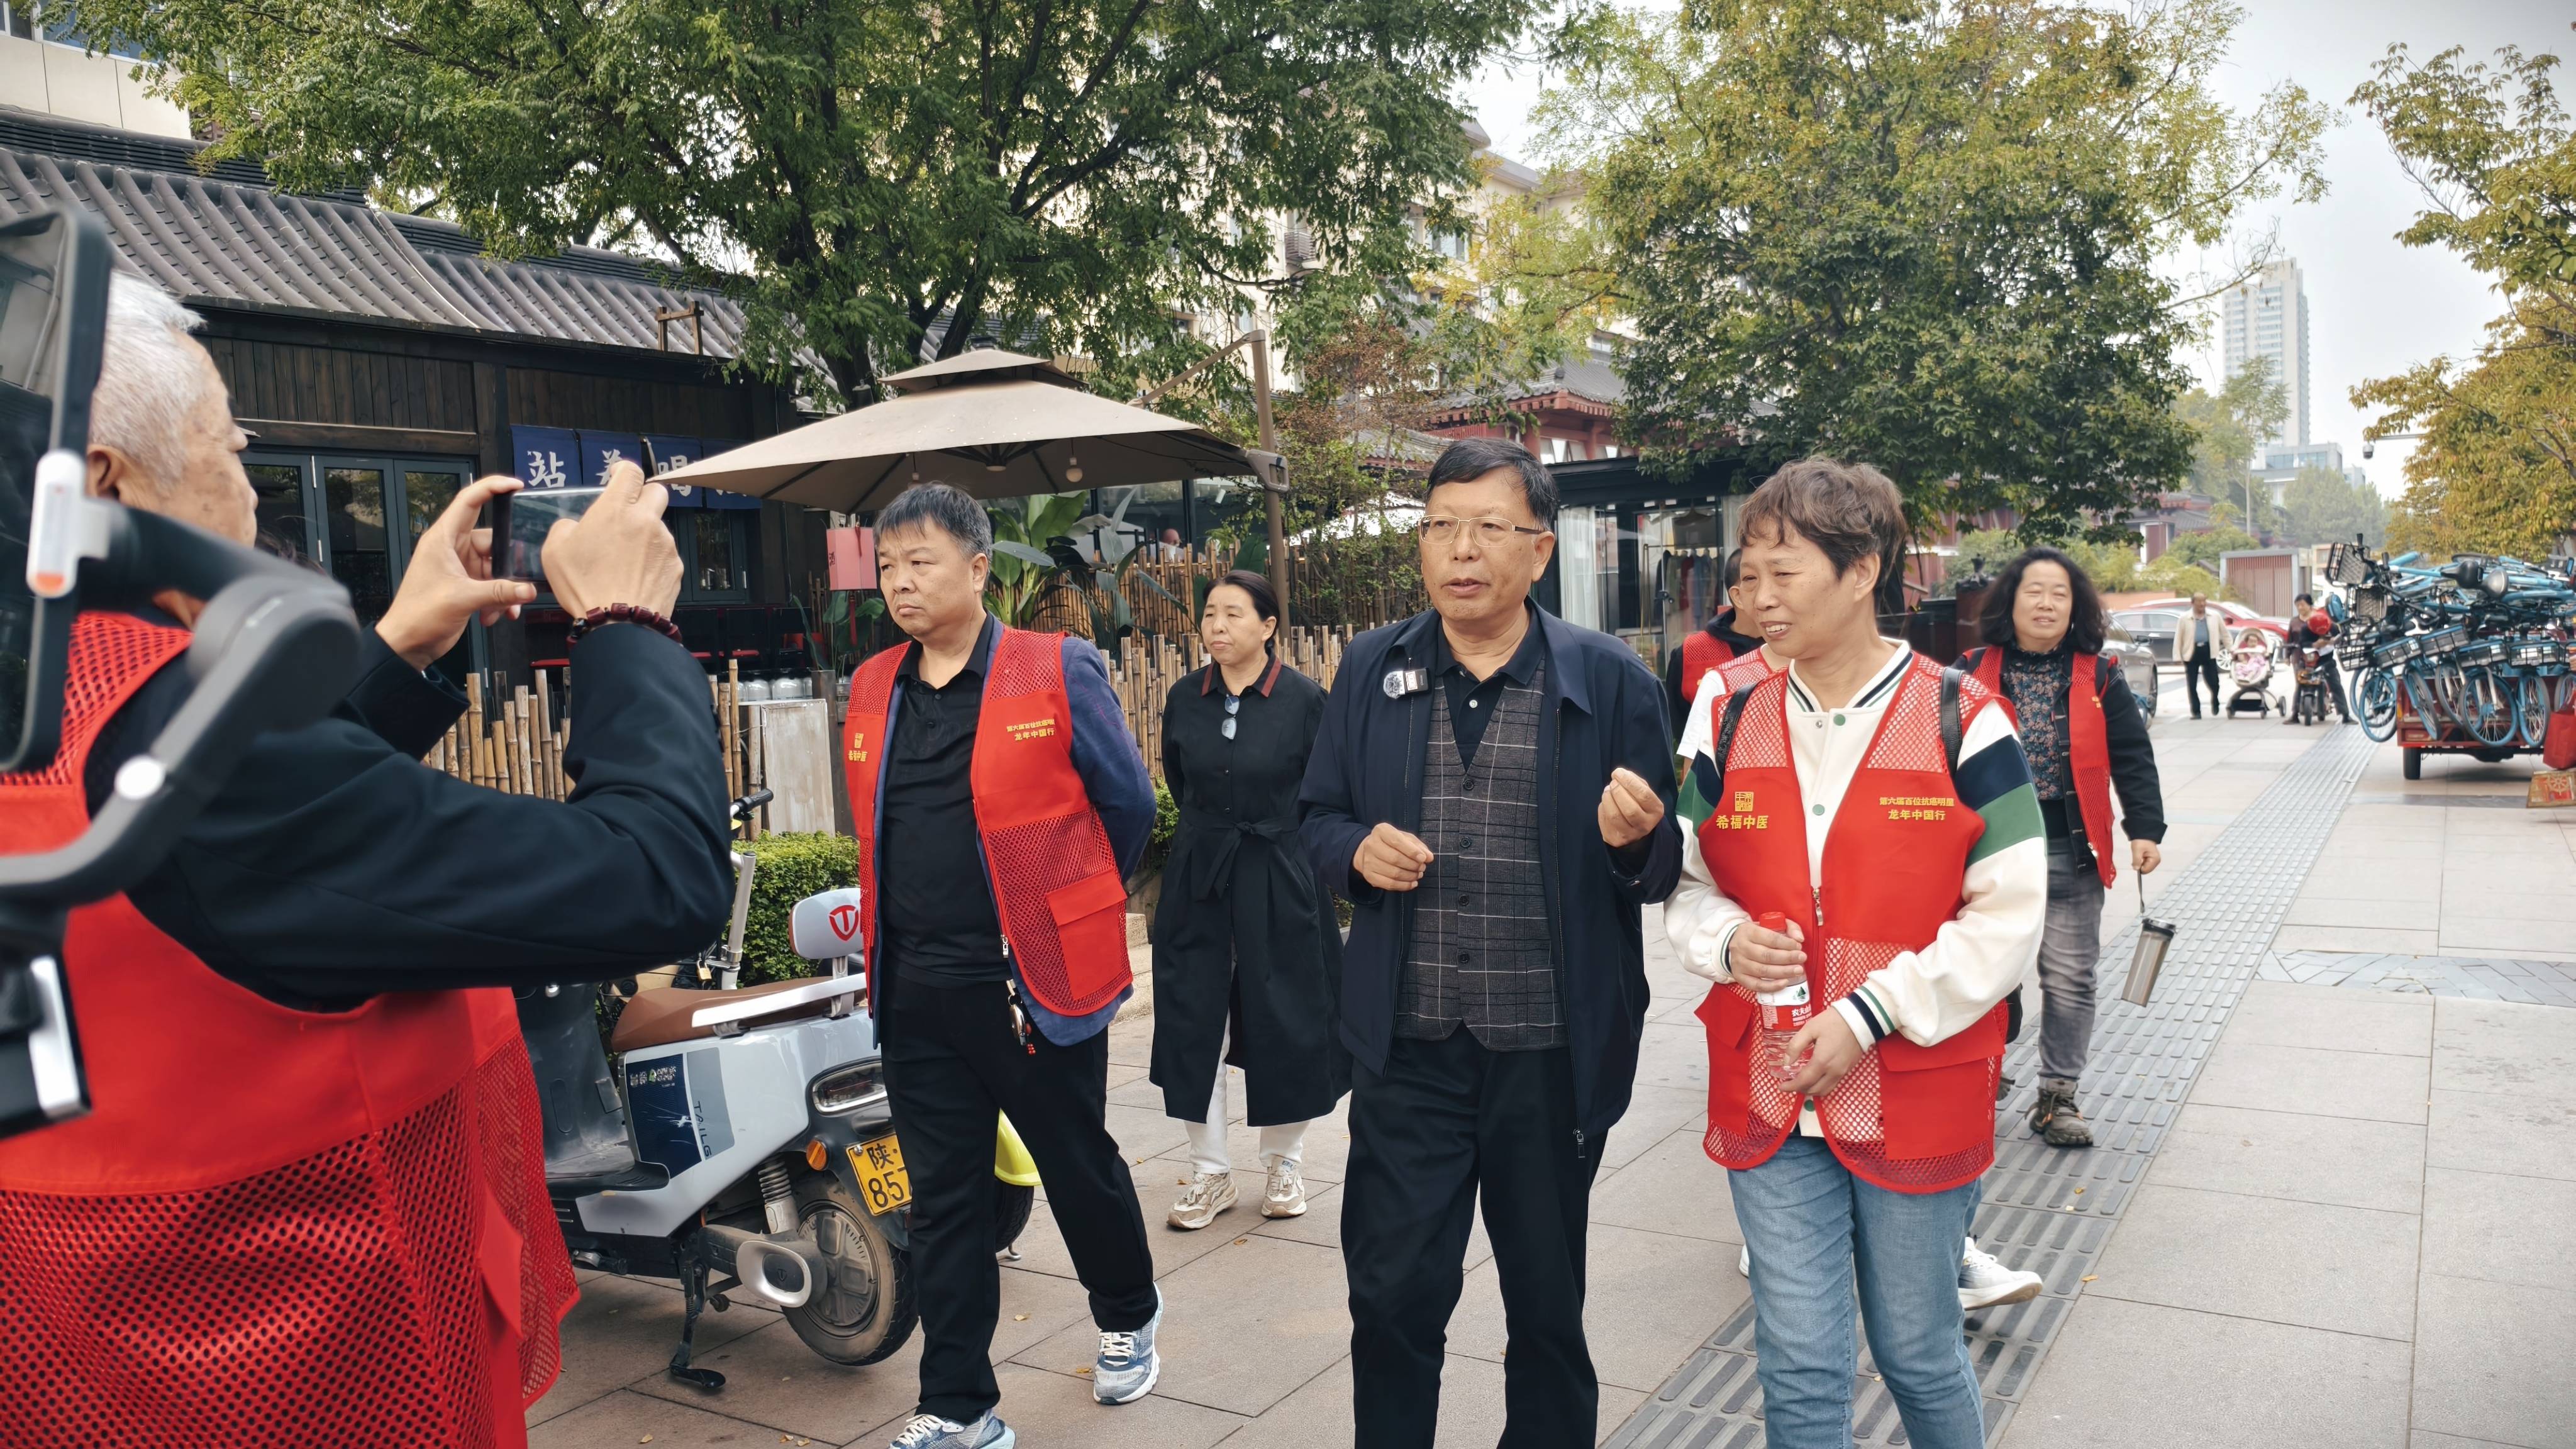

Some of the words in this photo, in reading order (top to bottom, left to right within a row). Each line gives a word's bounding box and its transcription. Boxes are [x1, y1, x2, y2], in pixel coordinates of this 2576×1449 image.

[1014, 728, 1055, 741] 龙年中国行
[1879, 797, 1955, 807] 第六届百位抗癌明星
[1888, 809, 1946, 821] 龙年中国行
[1715, 814, 1769, 830] 希福中医
[694, 1101, 712, 1157] TAILG
